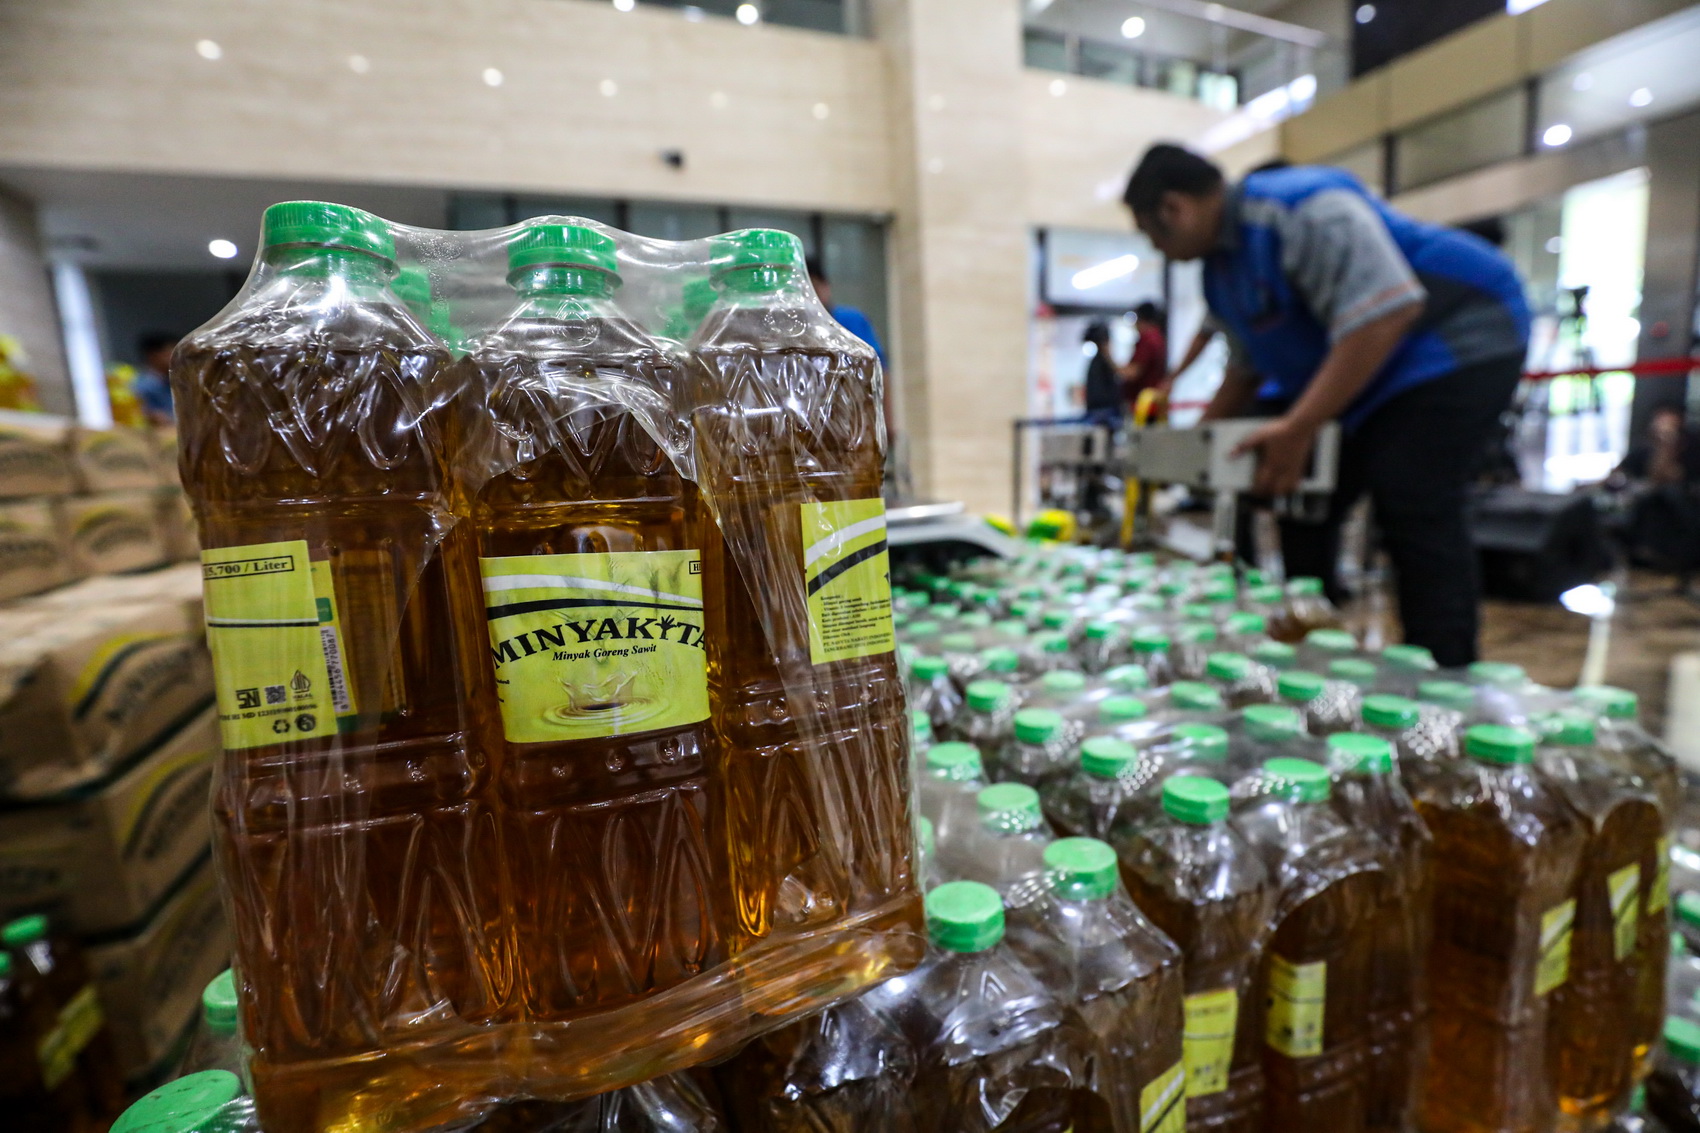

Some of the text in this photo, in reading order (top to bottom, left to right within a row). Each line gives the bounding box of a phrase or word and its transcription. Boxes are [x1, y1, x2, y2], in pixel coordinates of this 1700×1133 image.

[253, 560, 288, 572] Liter
[492, 614, 706, 670] MINYAKITA
[552, 644, 657, 662] Minyak Goreng Sawit
